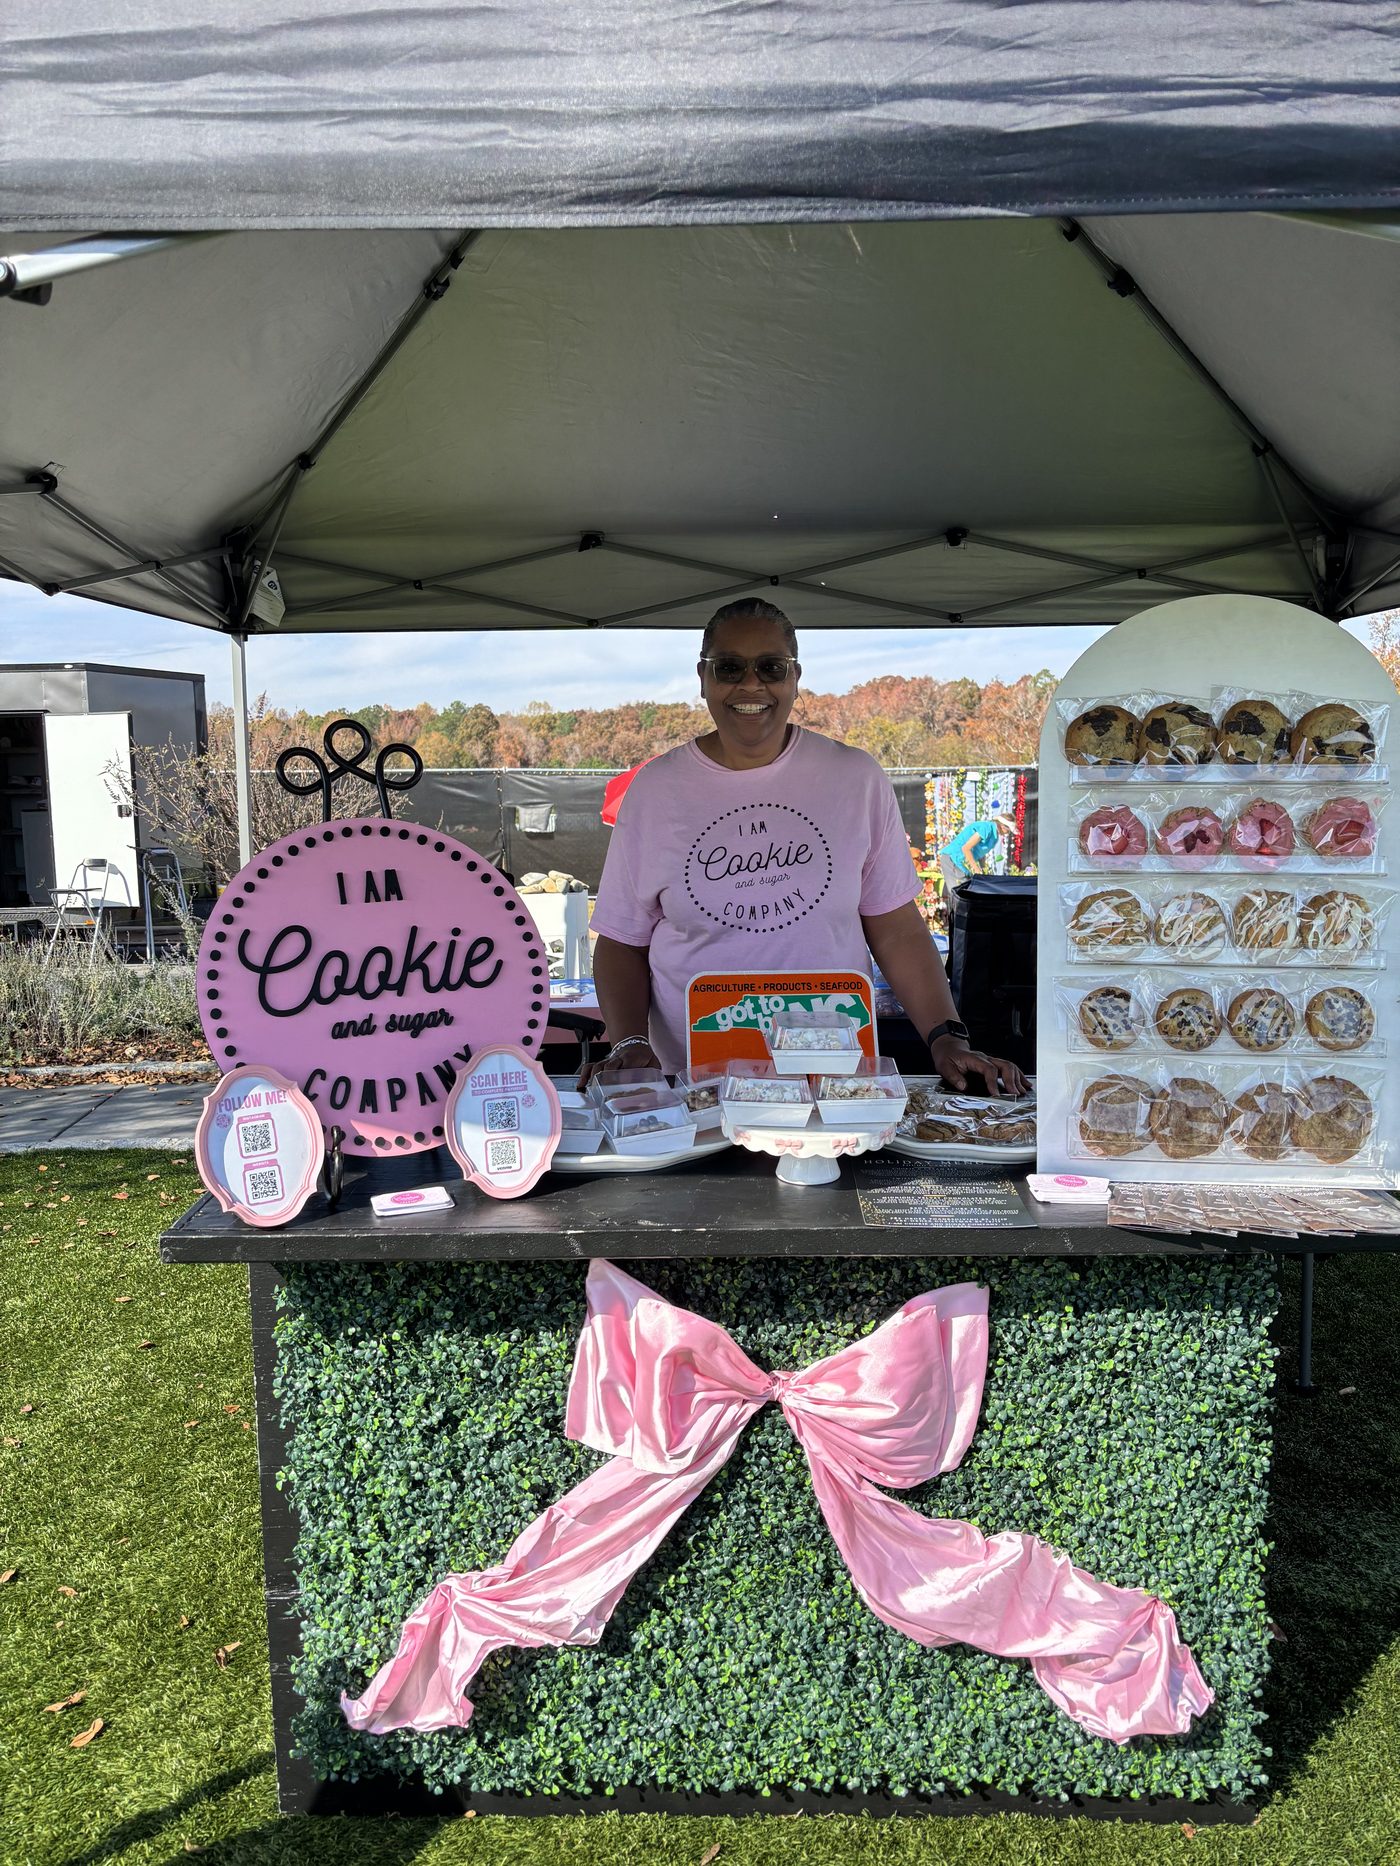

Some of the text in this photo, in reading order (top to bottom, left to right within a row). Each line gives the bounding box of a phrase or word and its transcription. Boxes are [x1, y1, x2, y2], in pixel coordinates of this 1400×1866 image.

[738, 821, 767, 837] I AM
[697, 840, 813, 881] Cookie
[336, 868, 404, 905] I AM
[734, 872, 791, 889] and sugar
[723, 887, 805, 921] COMPANY
[237, 925, 504, 1018] Cookie
[692, 981, 863, 993] AGRICULTURE PRODUCTS SEAFOOD
[331, 1007, 455, 1040] and sugar
[715, 995, 786, 1031] got to
[470, 1070, 528, 1089] SCAN HERE
[218, 1090, 287, 1112] FOLLOW ME!
